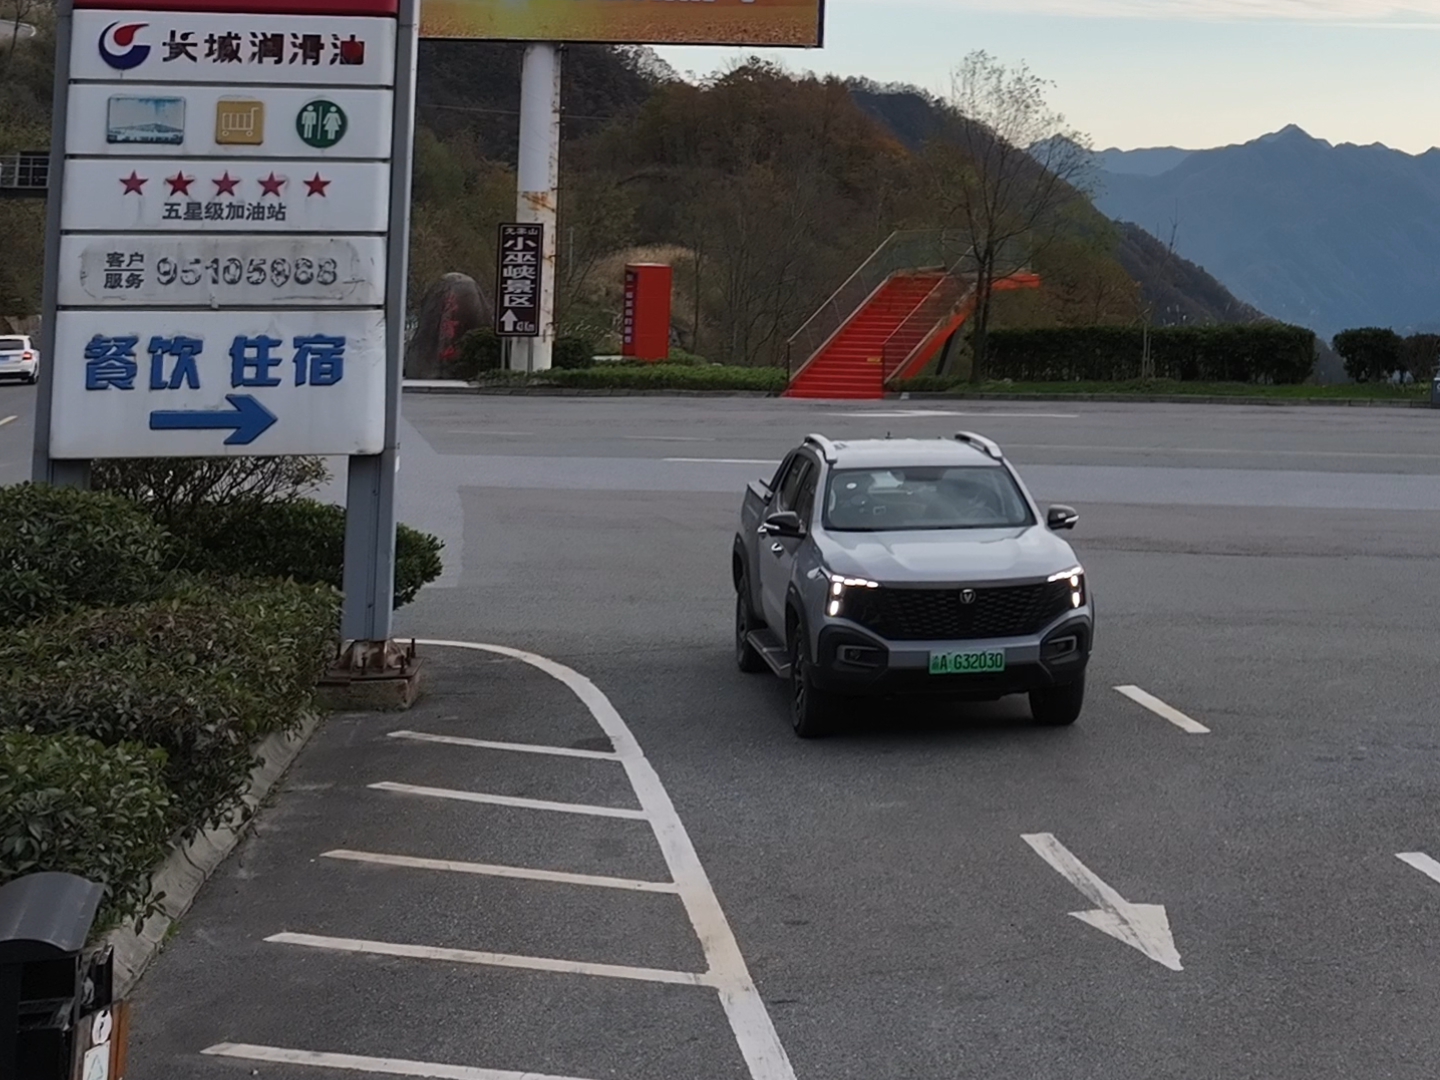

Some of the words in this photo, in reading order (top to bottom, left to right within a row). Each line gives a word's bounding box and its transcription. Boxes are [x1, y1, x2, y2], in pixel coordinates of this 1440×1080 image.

[162, 29, 365, 66] 长城润滑油
[162, 202, 287, 221] 五星级加油站
[106, 252, 144, 268] 客户
[104, 273, 144, 289] 服务
[501, 237, 538, 308] 小巫峡景区
[84, 333, 203, 391] 餐饮
[230, 333, 346, 388] 住宿
[954, 652, 1003, 670] G32030
